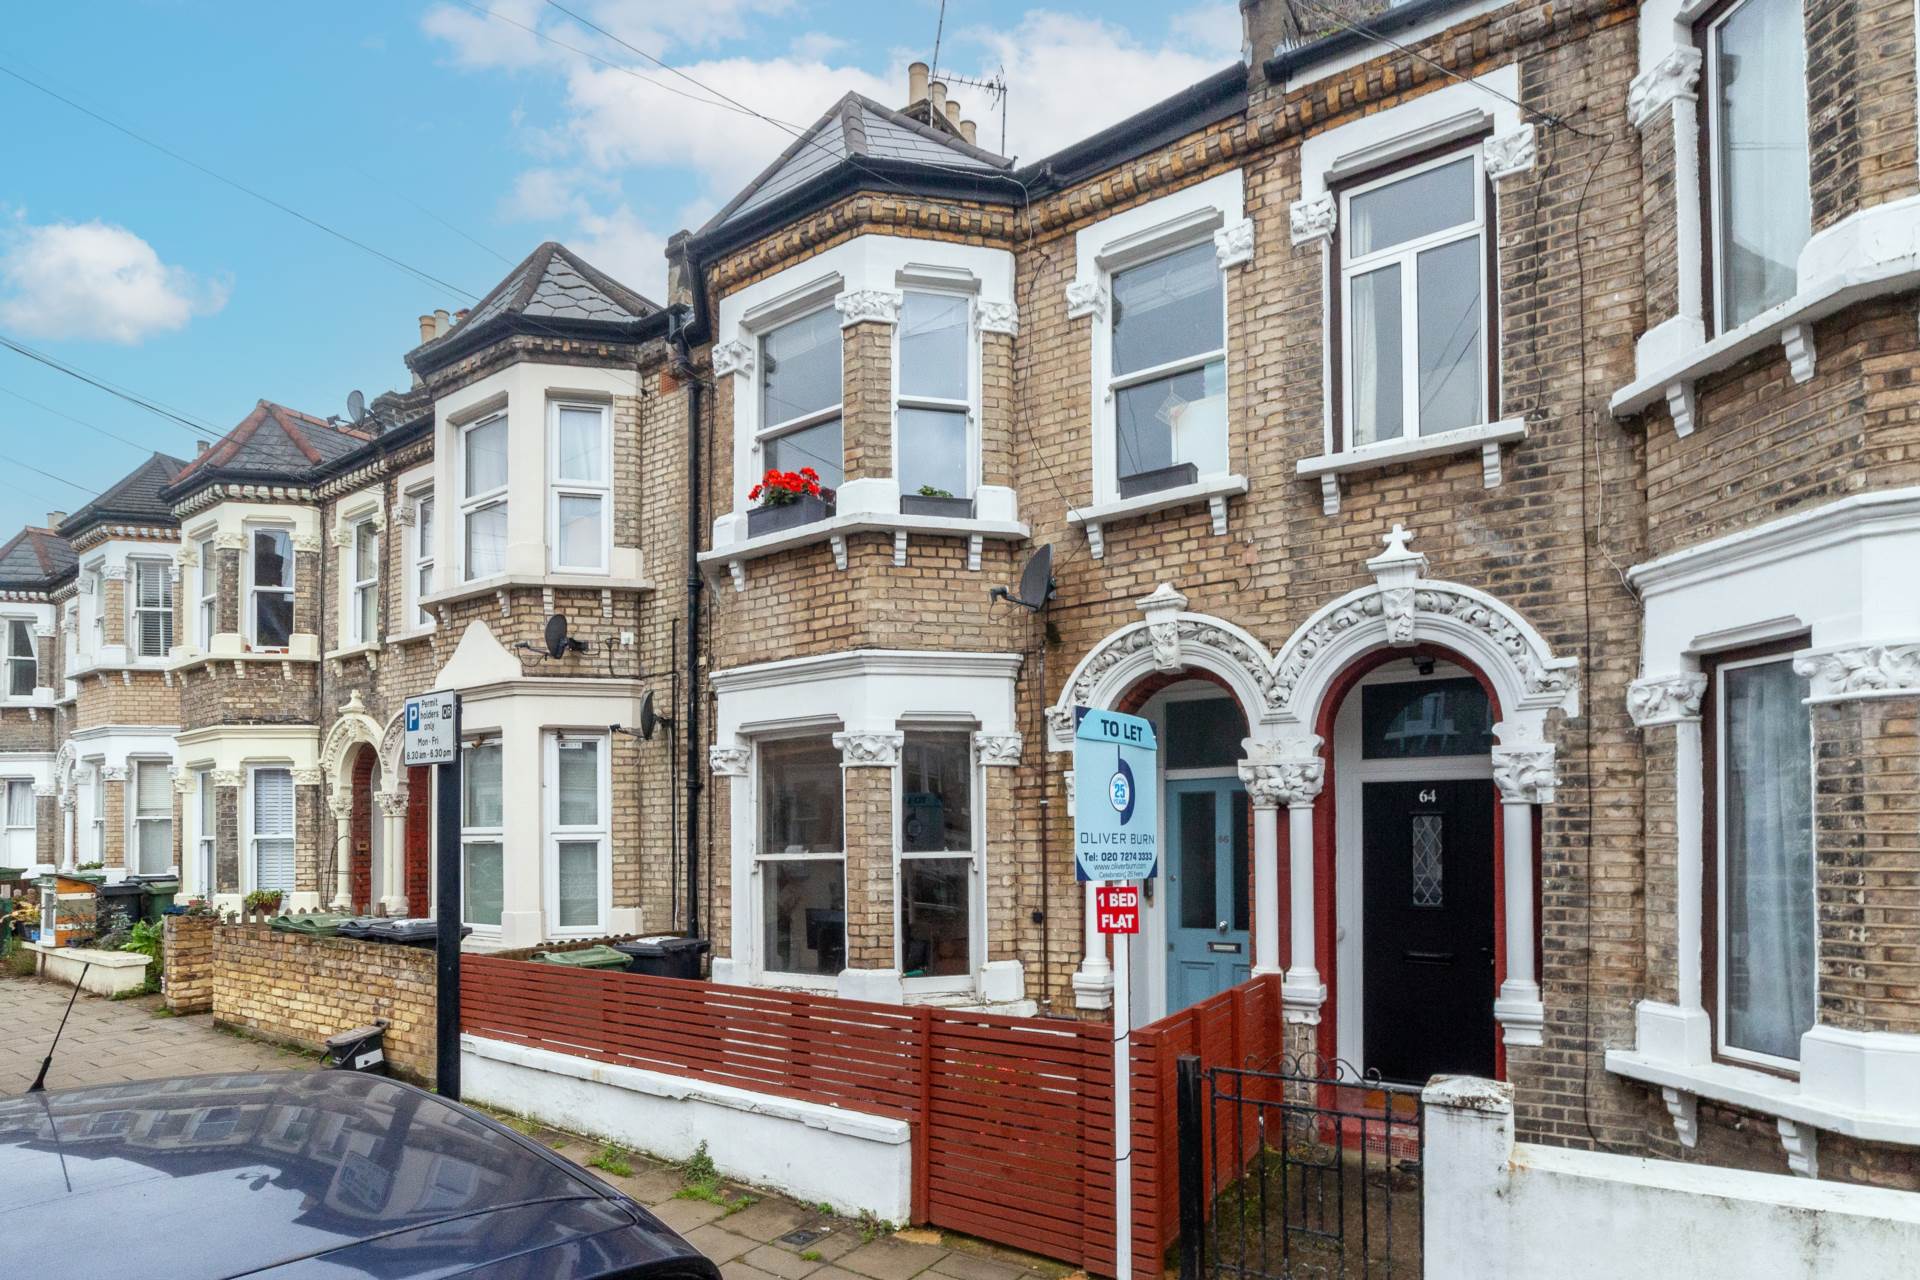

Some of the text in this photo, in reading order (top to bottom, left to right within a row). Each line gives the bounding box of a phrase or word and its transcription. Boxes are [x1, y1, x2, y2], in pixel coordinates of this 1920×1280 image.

[422, 698, 438, 707] Permit
[410, 707, 417, 728] P
[421, 711, 439, 719] holders
[424, 723, 435, 731] only
[1101, 719, 1143, 742] TO LET
[418, 738, 428, 746] Mon
[1114, 784, 1126, 798] 25
[1419, 789, 1437, 803] 64
[1080, 832, 1155, 845] OLIVER BURN
[1084, 852, 1098, 862] Tel:
[1101, 852, 1118, 862] 020
[1120, 852, 1136, 861] 7274
[1098, 892, 1137, 908] 1 BED
[1101, 913, 1135, 929] FLAT
